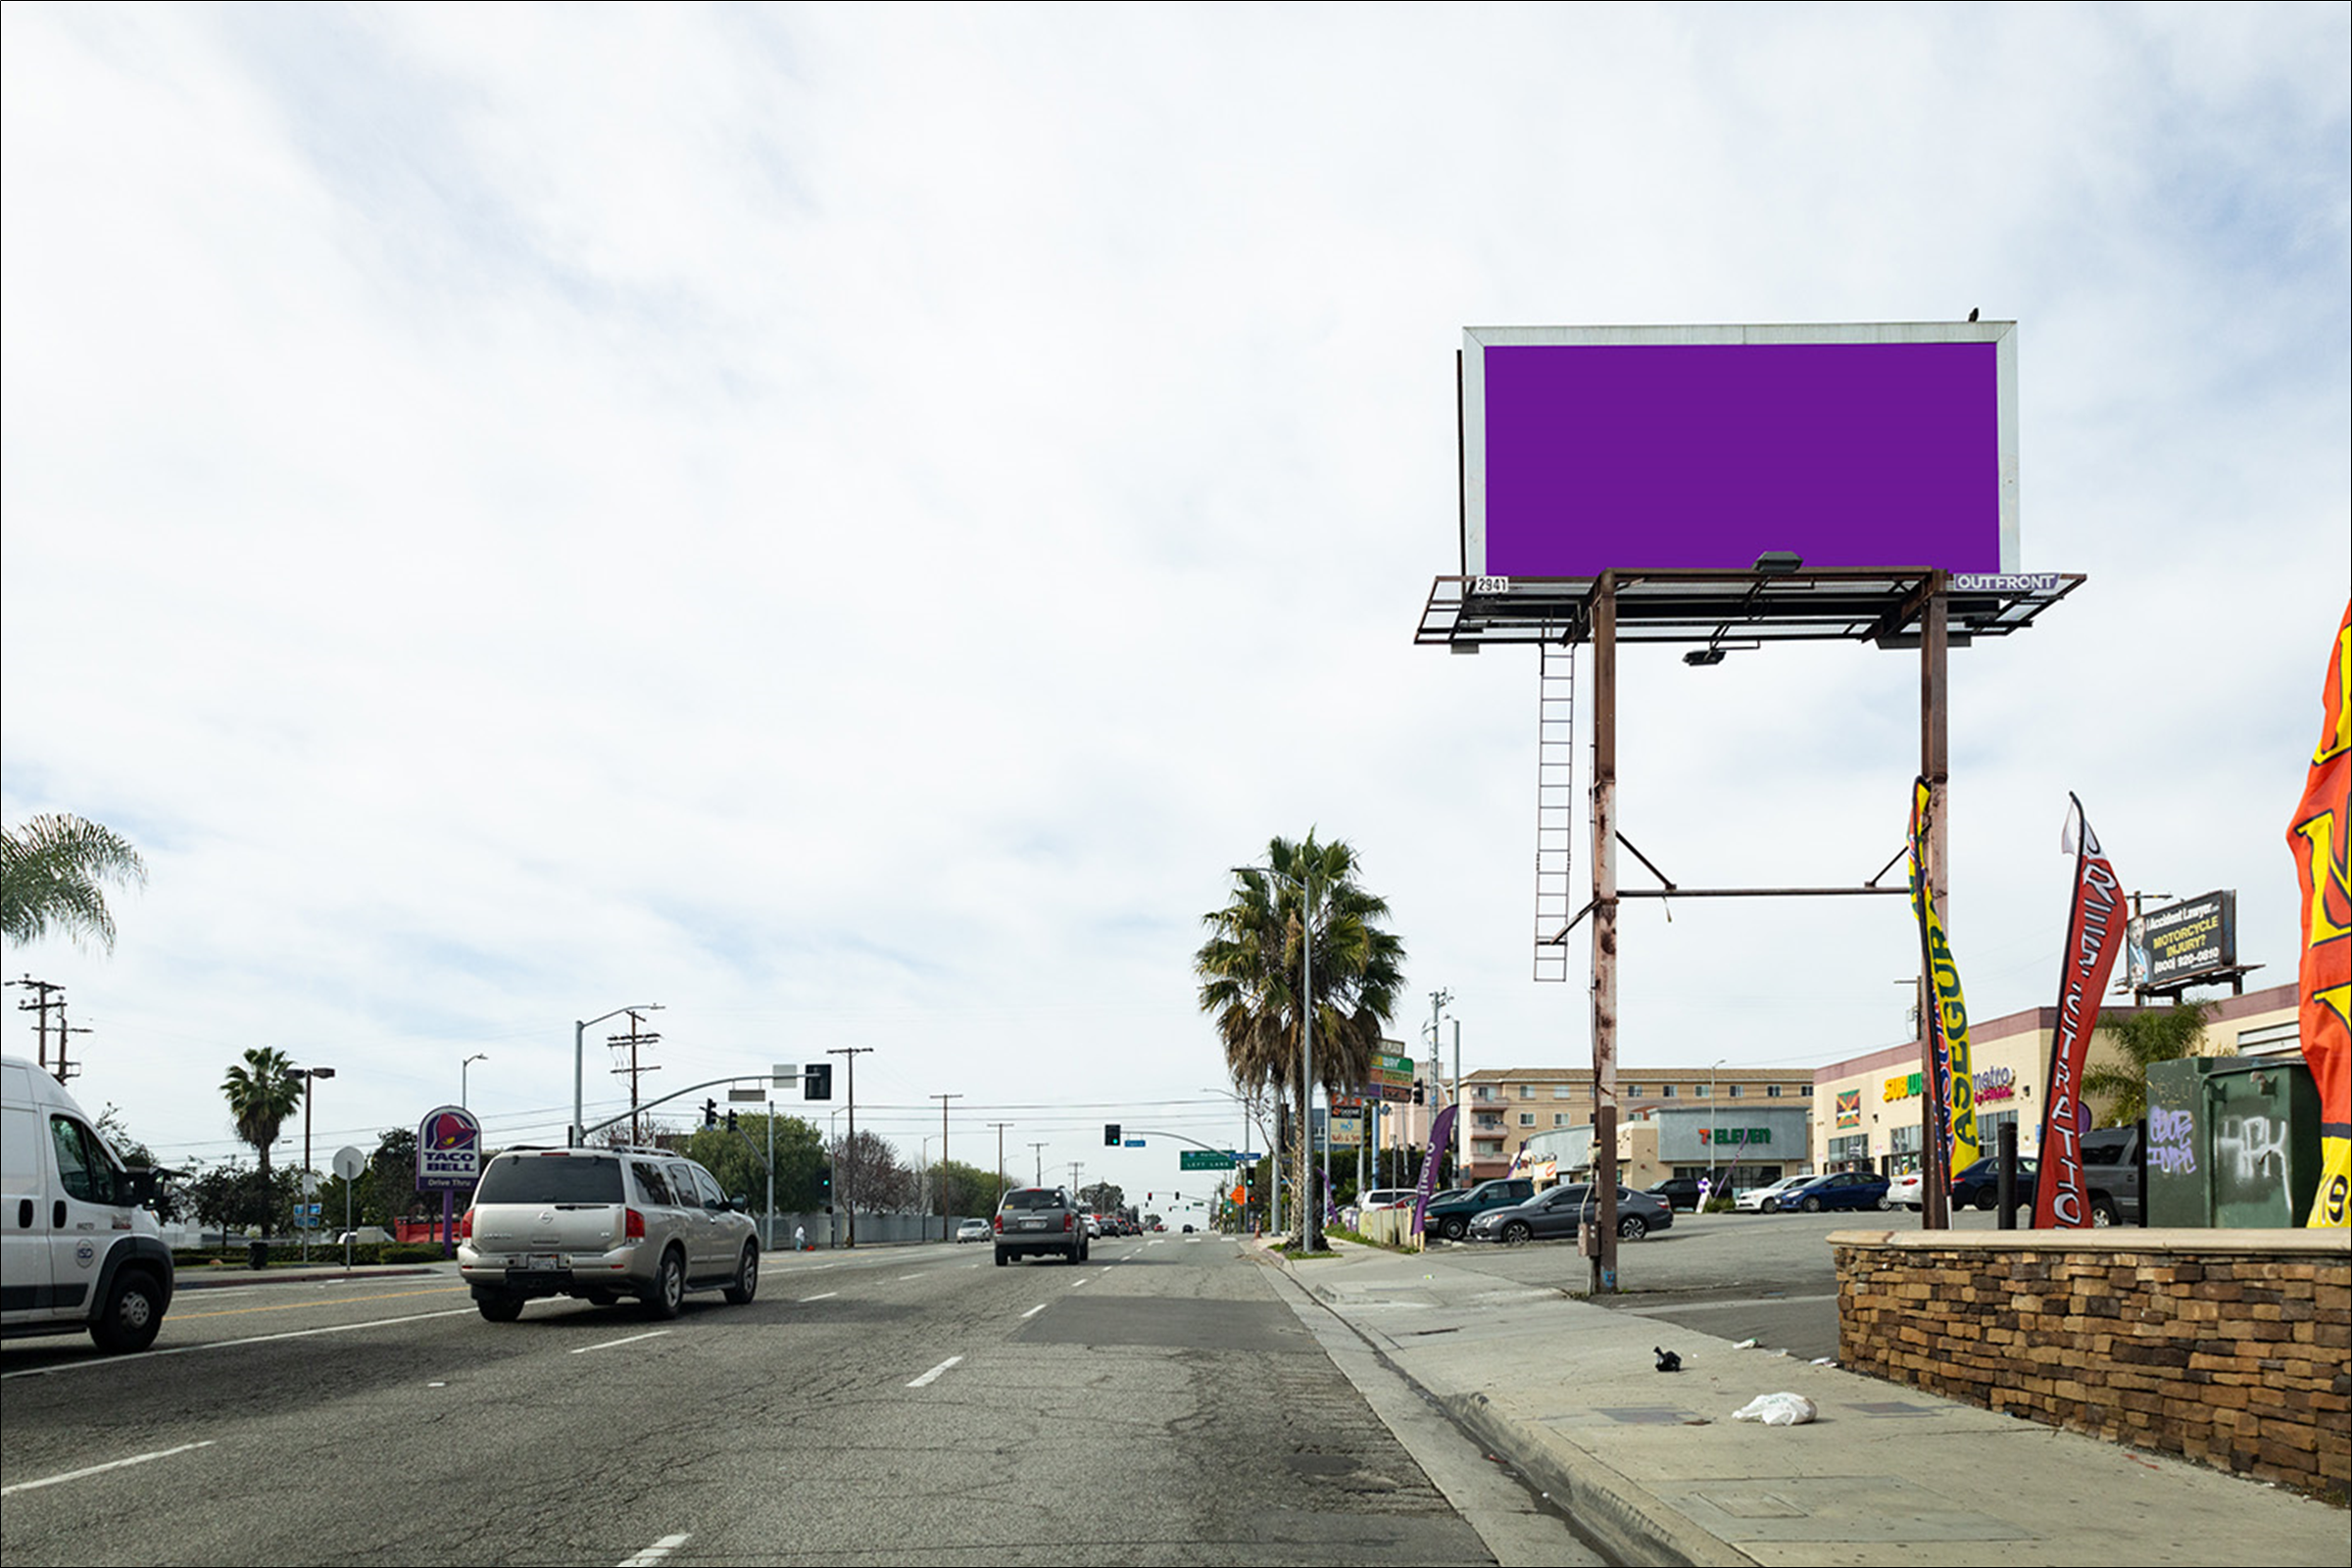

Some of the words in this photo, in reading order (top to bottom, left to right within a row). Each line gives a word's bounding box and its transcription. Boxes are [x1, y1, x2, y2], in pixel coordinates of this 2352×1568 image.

[1478, 578, 1506, 592] 2941
[1957, 574, 2056, 589] OUTFRONT
[2152, 915, 2219, 950] MOTORCYCLE
[2166, 934, 2207, 957] INJURY?
[1929, 899, 1978, 1149] ASEGUR
[423, 1152, 475, 1162] TACO
[426, 1163, 475, 1172] BELL
